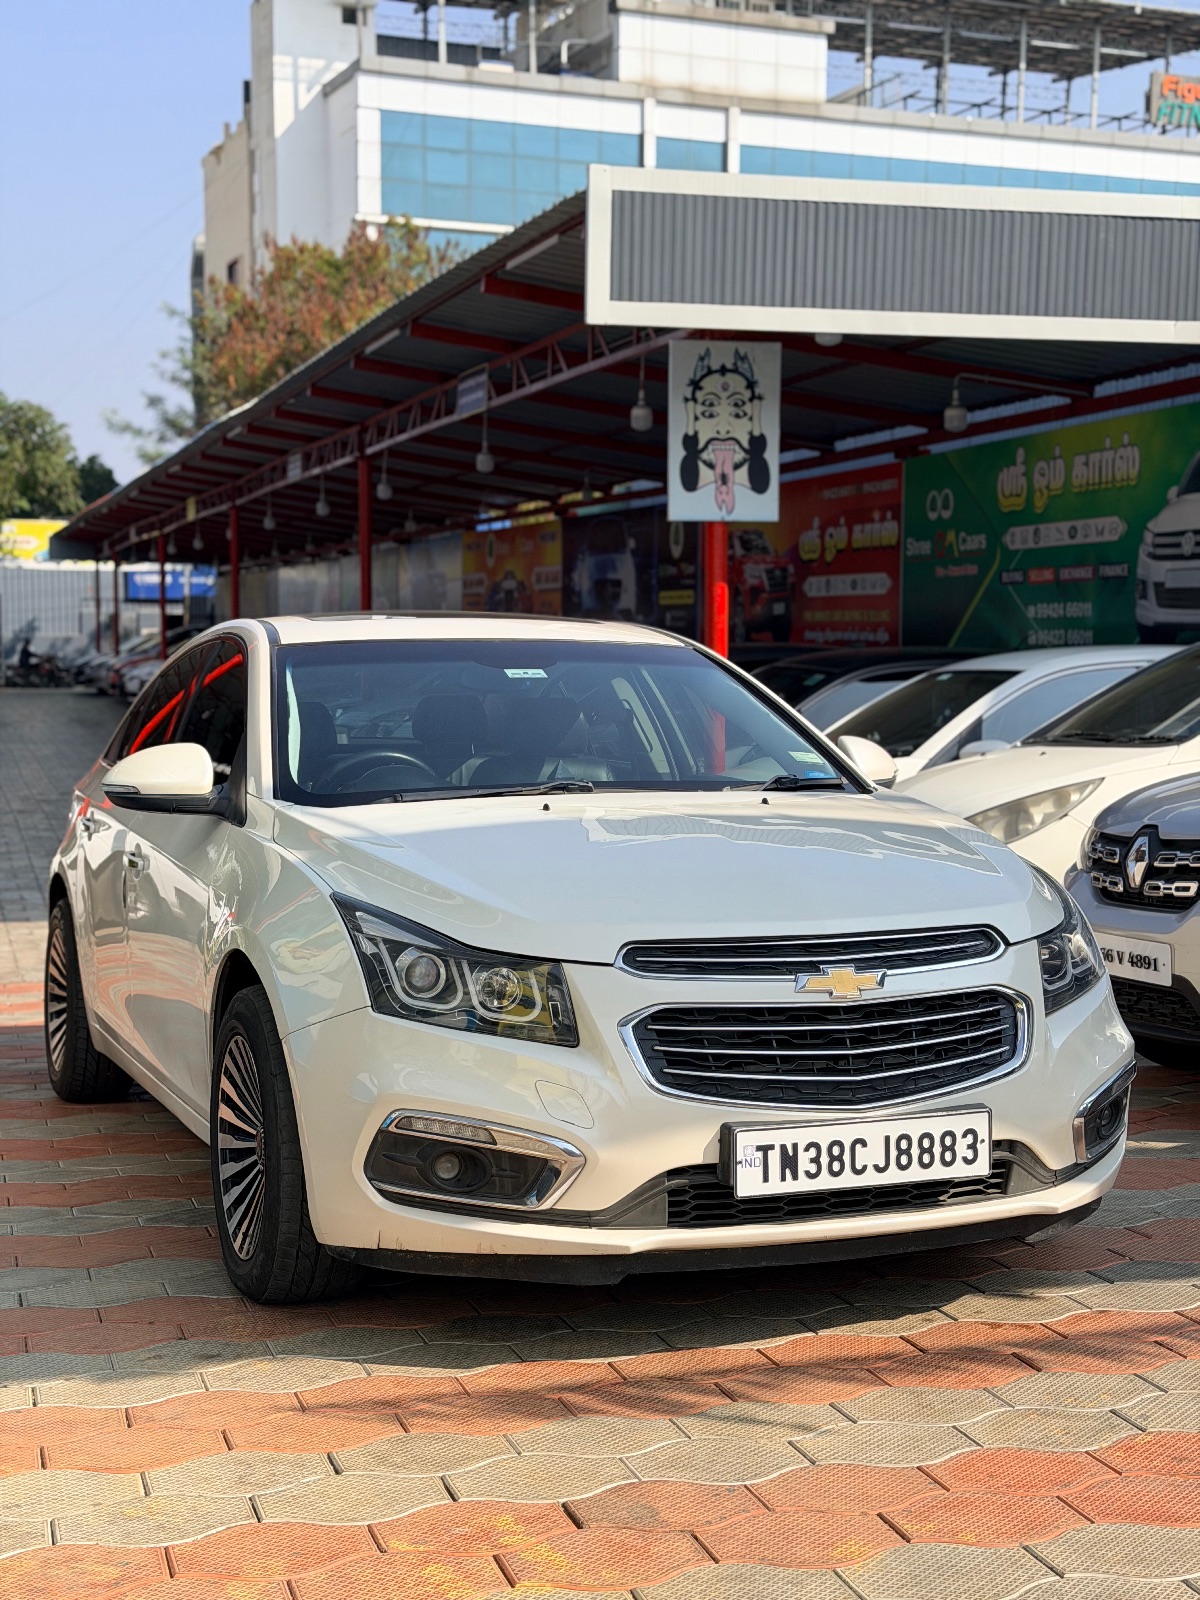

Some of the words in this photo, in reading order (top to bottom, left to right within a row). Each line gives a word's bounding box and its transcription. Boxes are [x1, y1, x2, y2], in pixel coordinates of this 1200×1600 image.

[905, 537, 933, 557] Shree
[1099, 563, 1129, 578] FINANCE
[1116, 950, 1125, 965] V
[1127, 951, 1160, 971] 4891
[755, 1128, 979, 1183] TN38CJ8883
